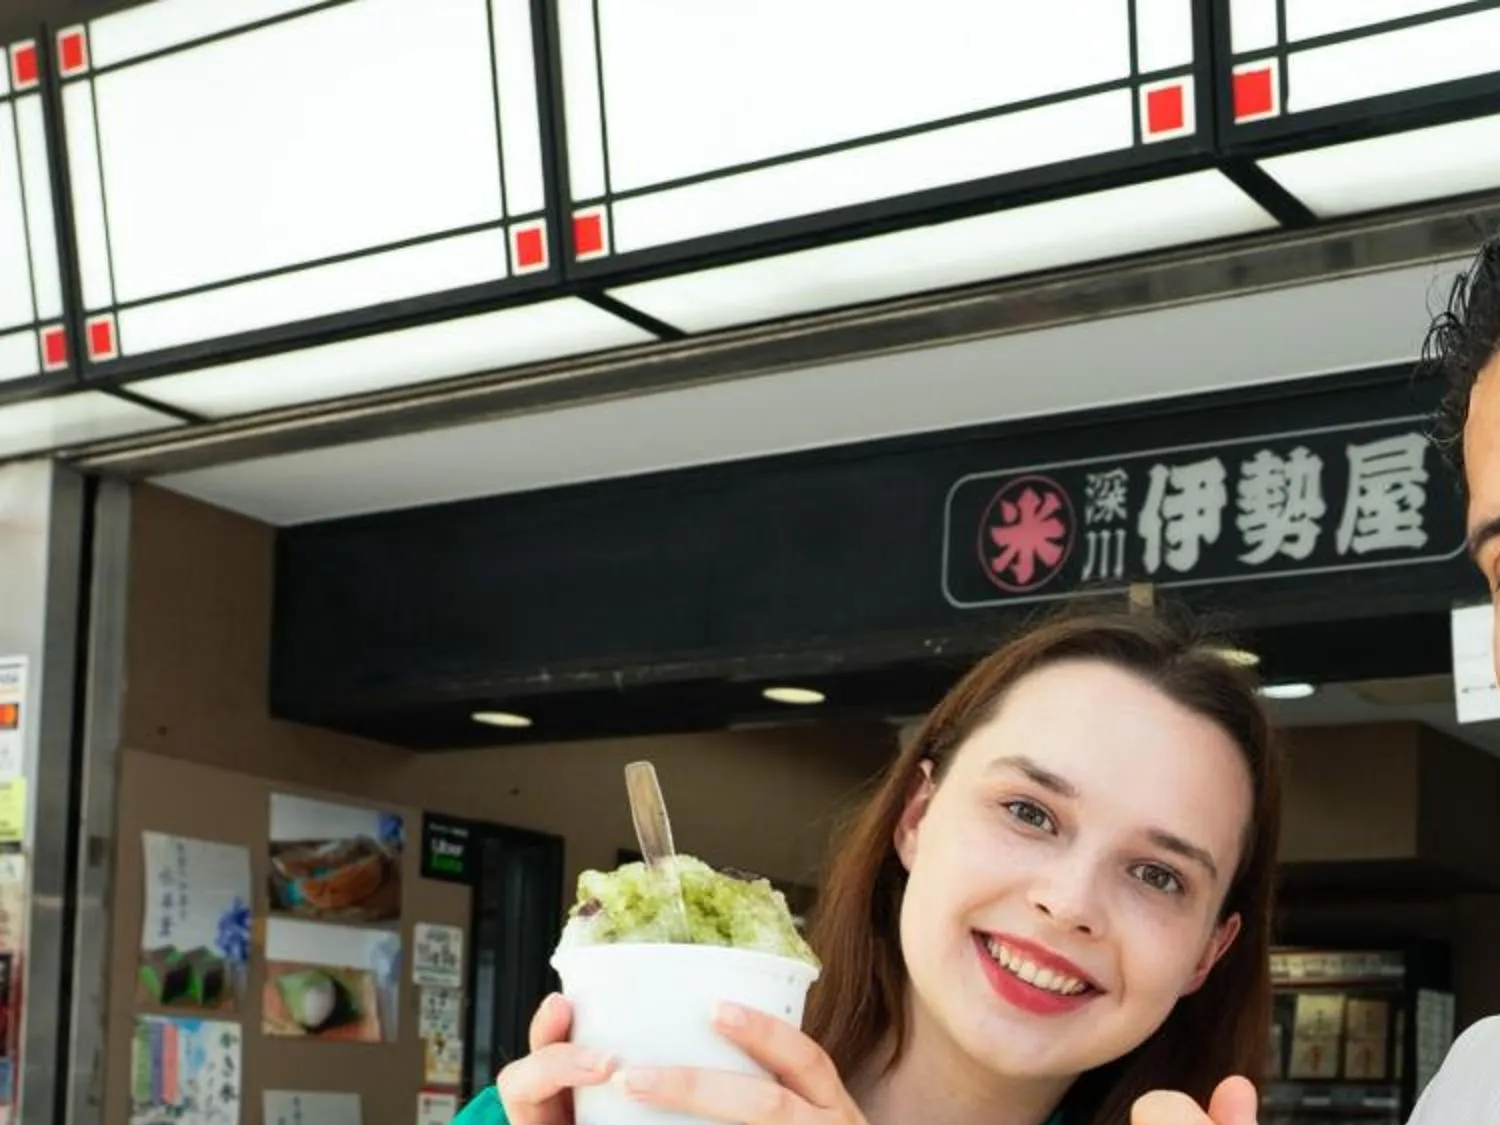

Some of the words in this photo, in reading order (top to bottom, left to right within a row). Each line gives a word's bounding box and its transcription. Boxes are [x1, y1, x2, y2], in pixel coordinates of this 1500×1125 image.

[1081, 467, 1129, 582] 深川
[1137, 431, 1431, 575] 伊勢屋
